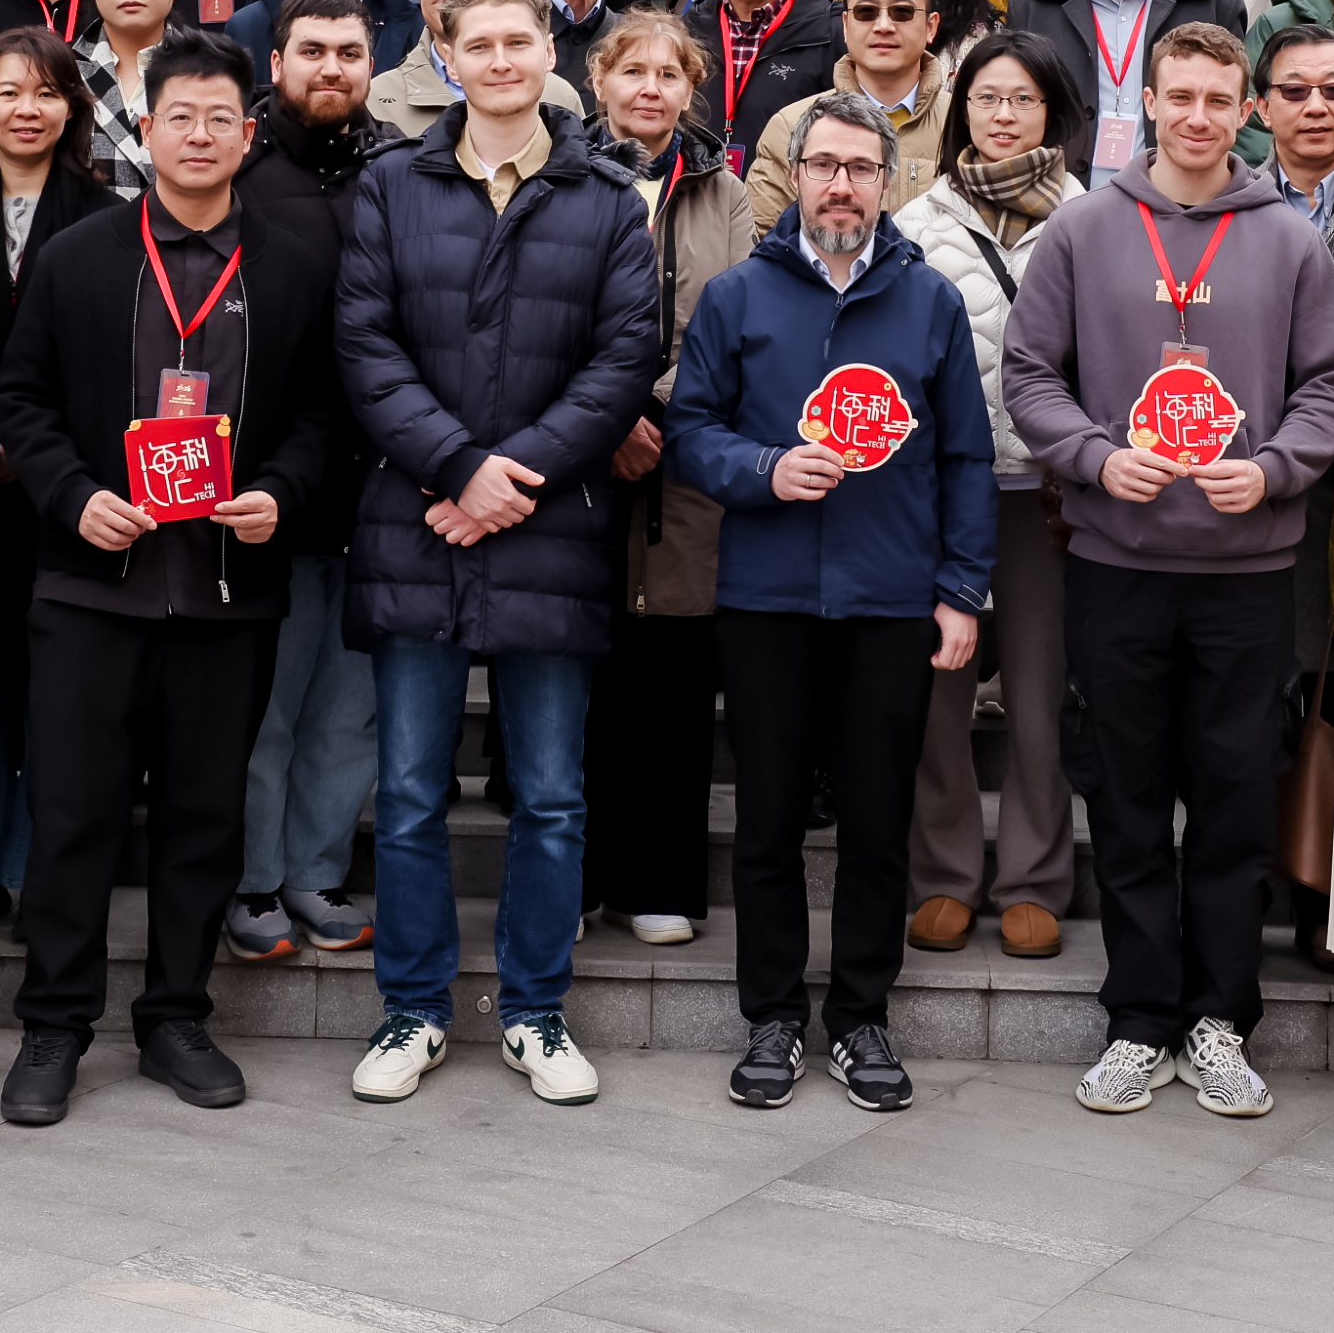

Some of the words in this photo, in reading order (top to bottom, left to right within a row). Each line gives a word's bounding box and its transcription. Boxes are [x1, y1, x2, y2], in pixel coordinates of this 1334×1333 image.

[867, 440, 886, 449] TECH
[1198, 439, 1216, 447] TECH
[194, 490, 216, 502] TECH
